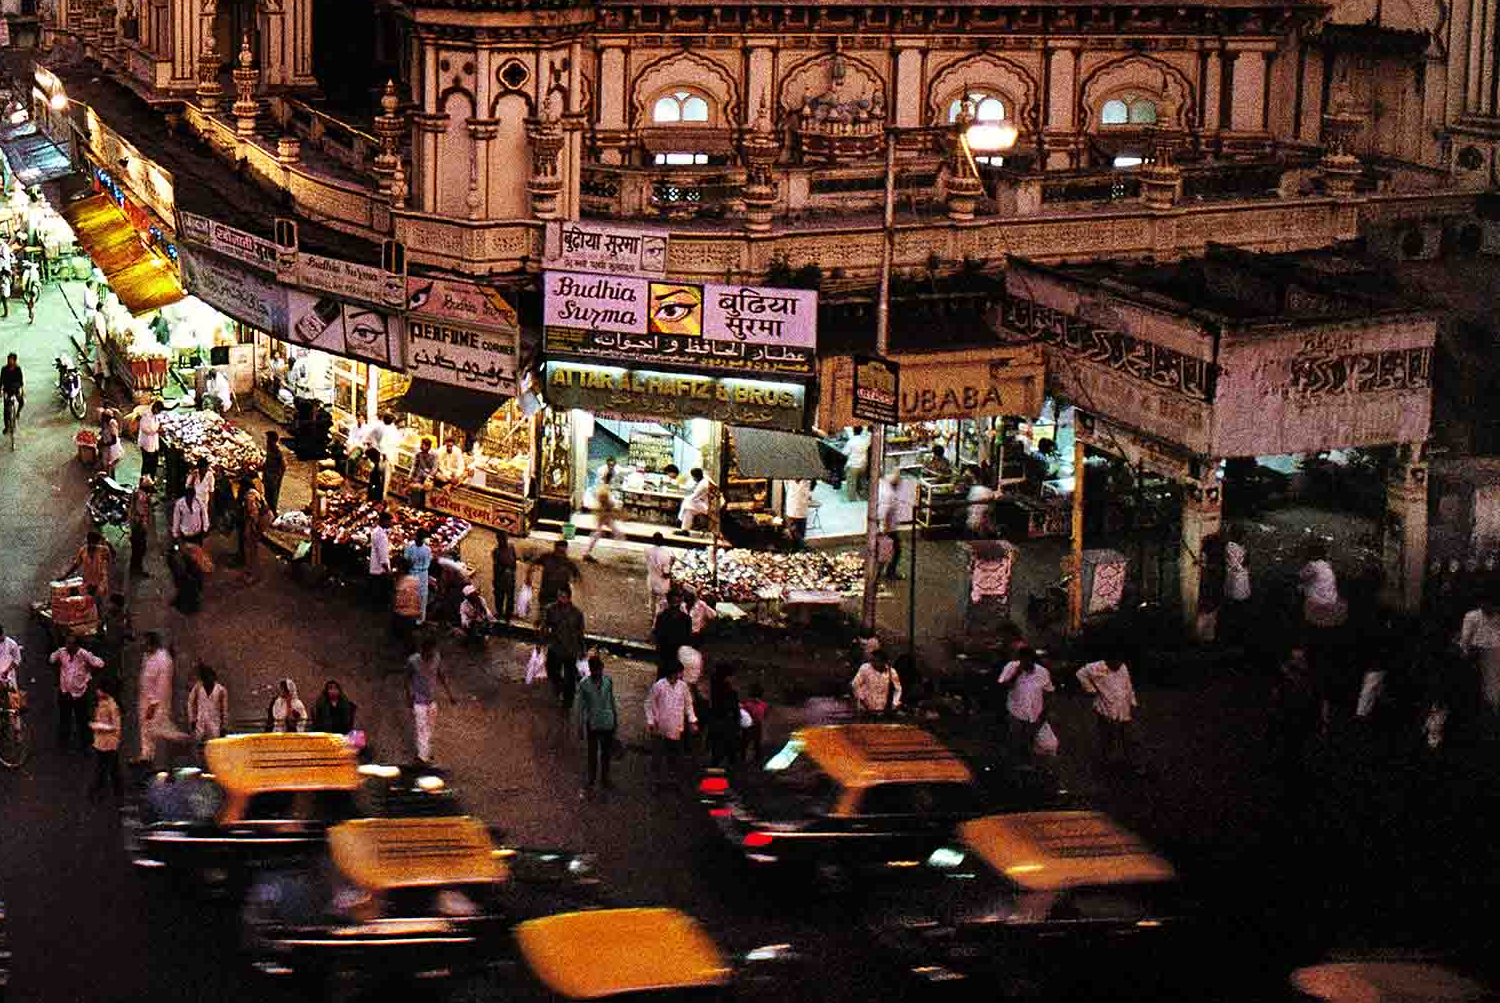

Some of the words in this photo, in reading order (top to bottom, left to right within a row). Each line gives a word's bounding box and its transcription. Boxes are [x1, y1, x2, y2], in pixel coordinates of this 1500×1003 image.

[604, 234, 641, 257] सुरमा
[552, 275, 638, 303] Budhia
[719, 287, 801, 317] बुढिया
[557, 299, 638, 330] Surma
[725, 316, 786, 340] सुरमा
[410, 324, 479, 349] PERFUME
[482, 340, 516, 356] CORNER
[684, 337, 745, 358] الحافظ
[752, 345, 806, 363] عطار
[552, 368, 613, 389] ATTAR
[620, 370, 645, 393] AL
[648, 374, 710, 400] HAFIZ
